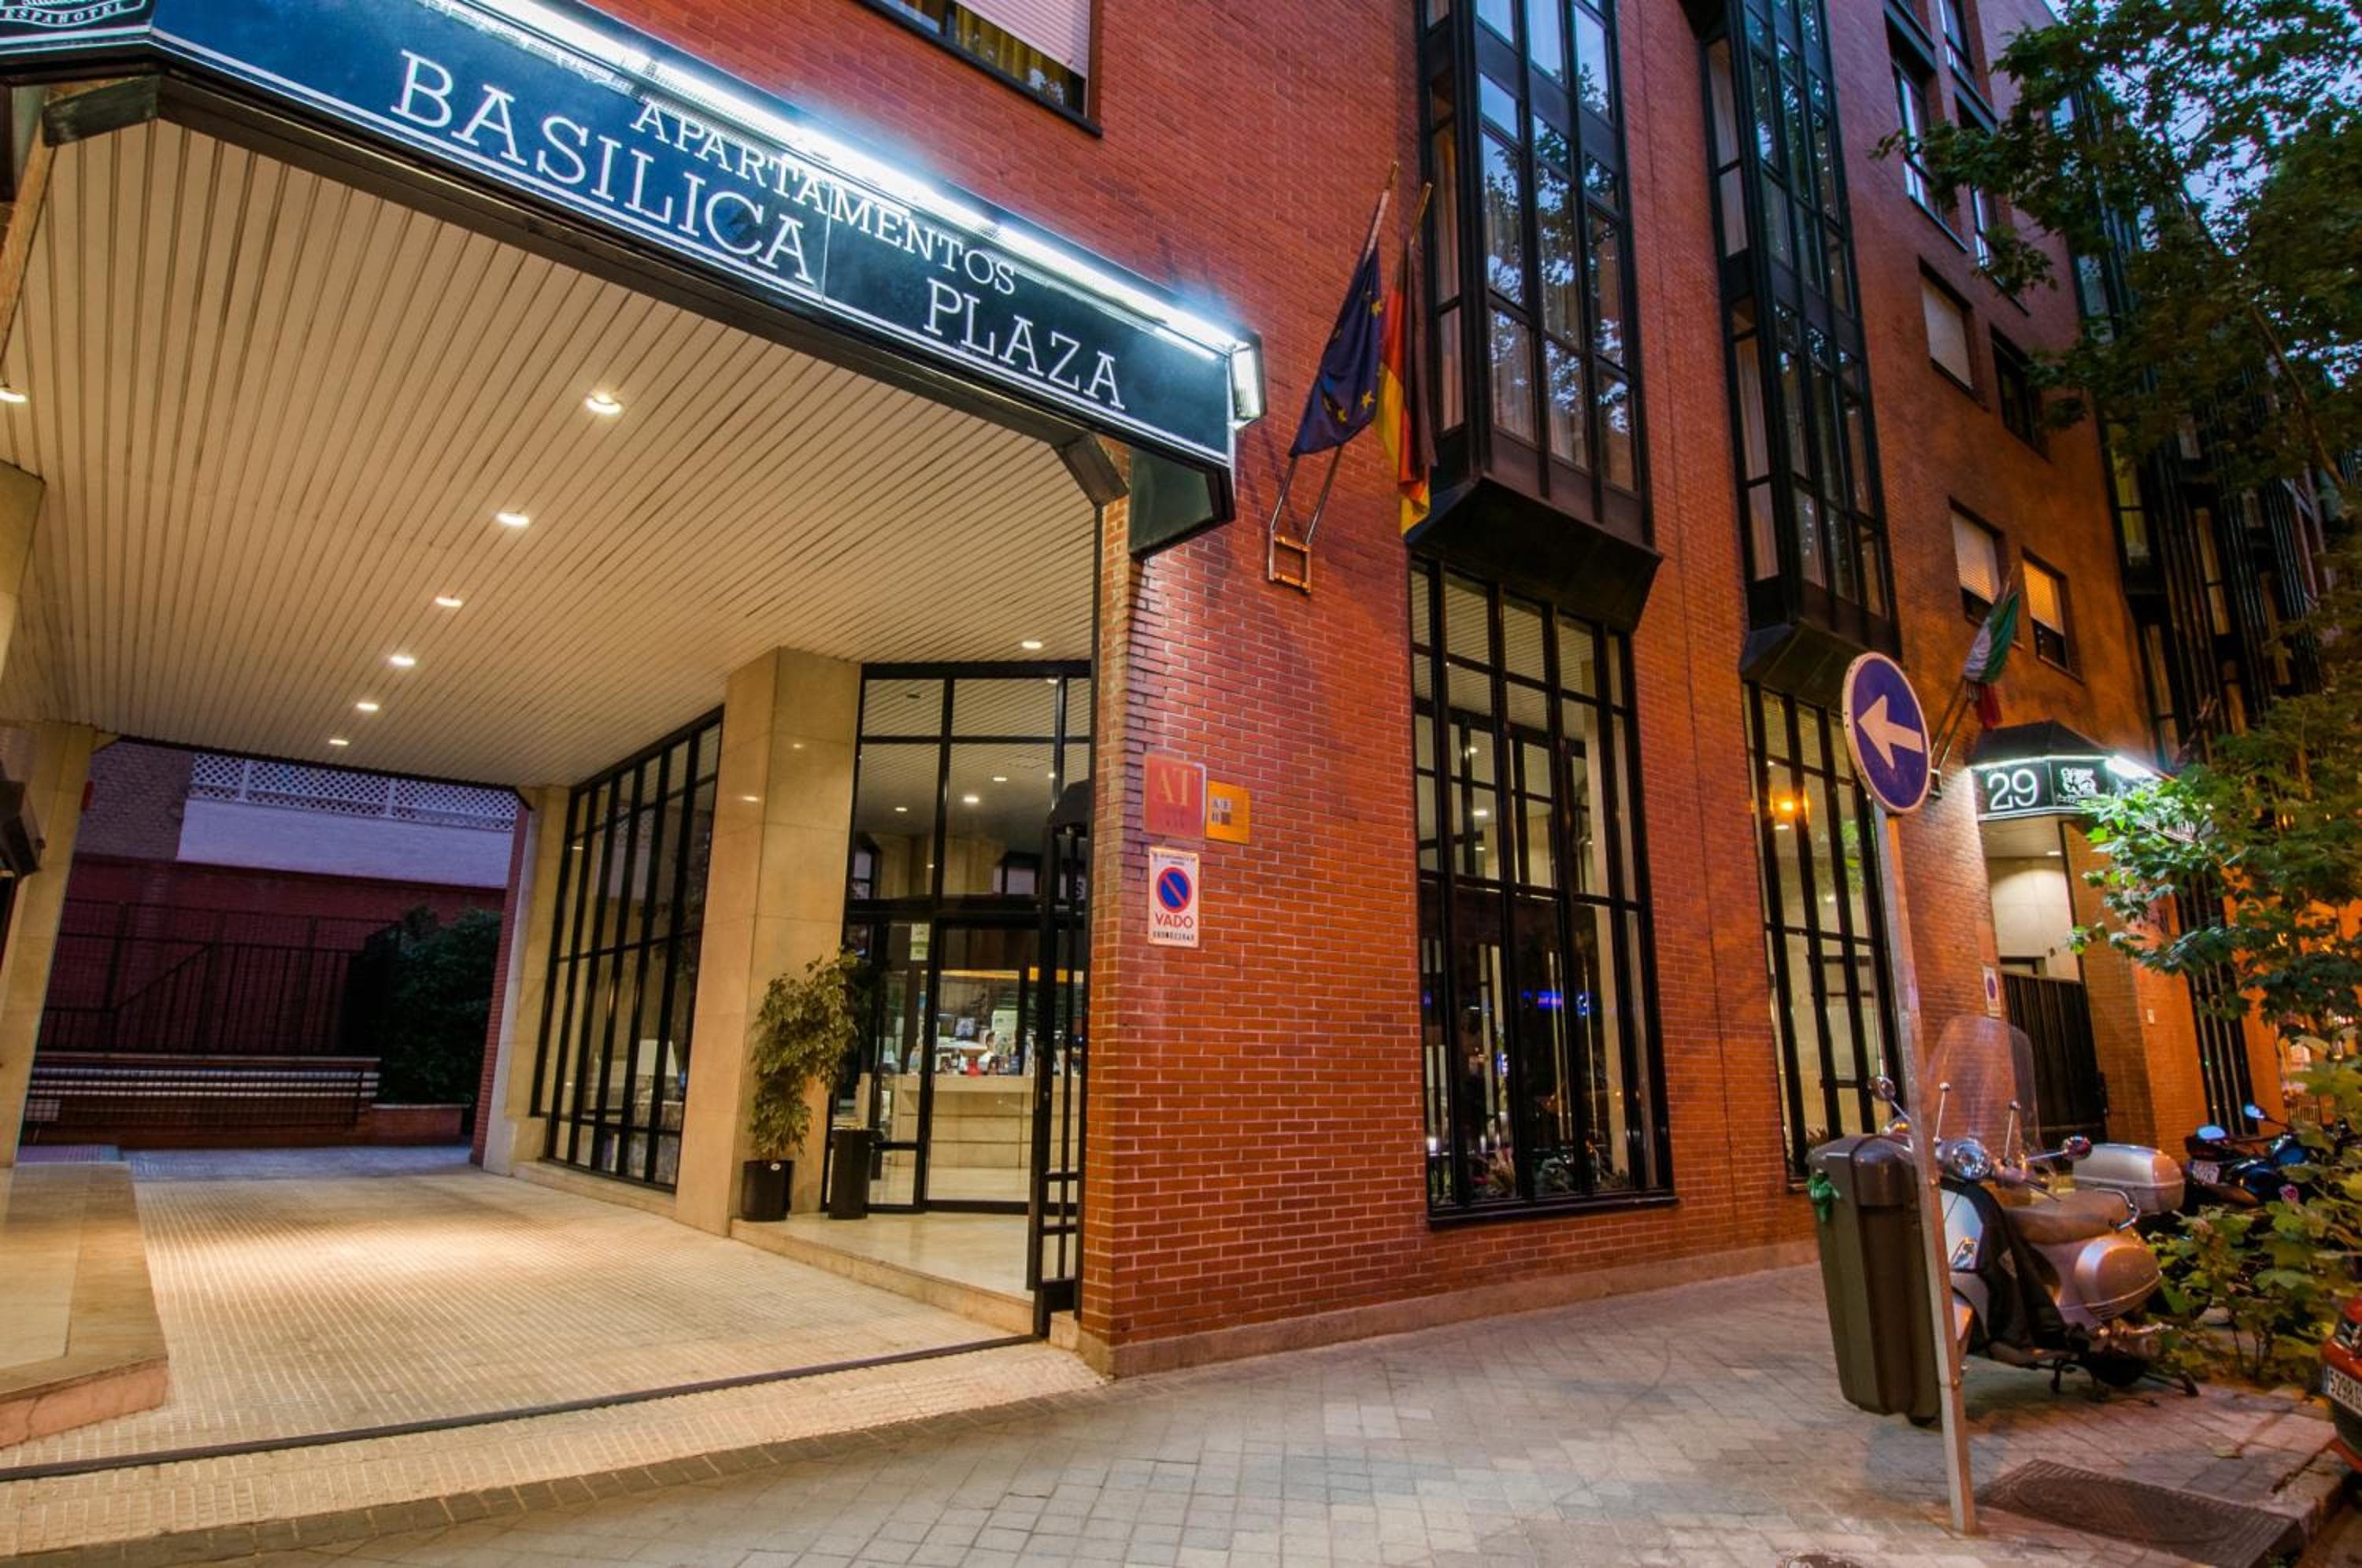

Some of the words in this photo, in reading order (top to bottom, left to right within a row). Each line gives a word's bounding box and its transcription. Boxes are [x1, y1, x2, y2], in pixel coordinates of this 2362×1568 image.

[4, 2, 125, 24] ESPAHOTEL
[629, 95, 1016, 295] APARTAMENTOS
[389, 48, 814, 286] BASILICA
[923, 276, 1126, 410] PLAZA
[1987, 767, 2038, 811] 29
[1154, 912, 1194, 929] VADO
